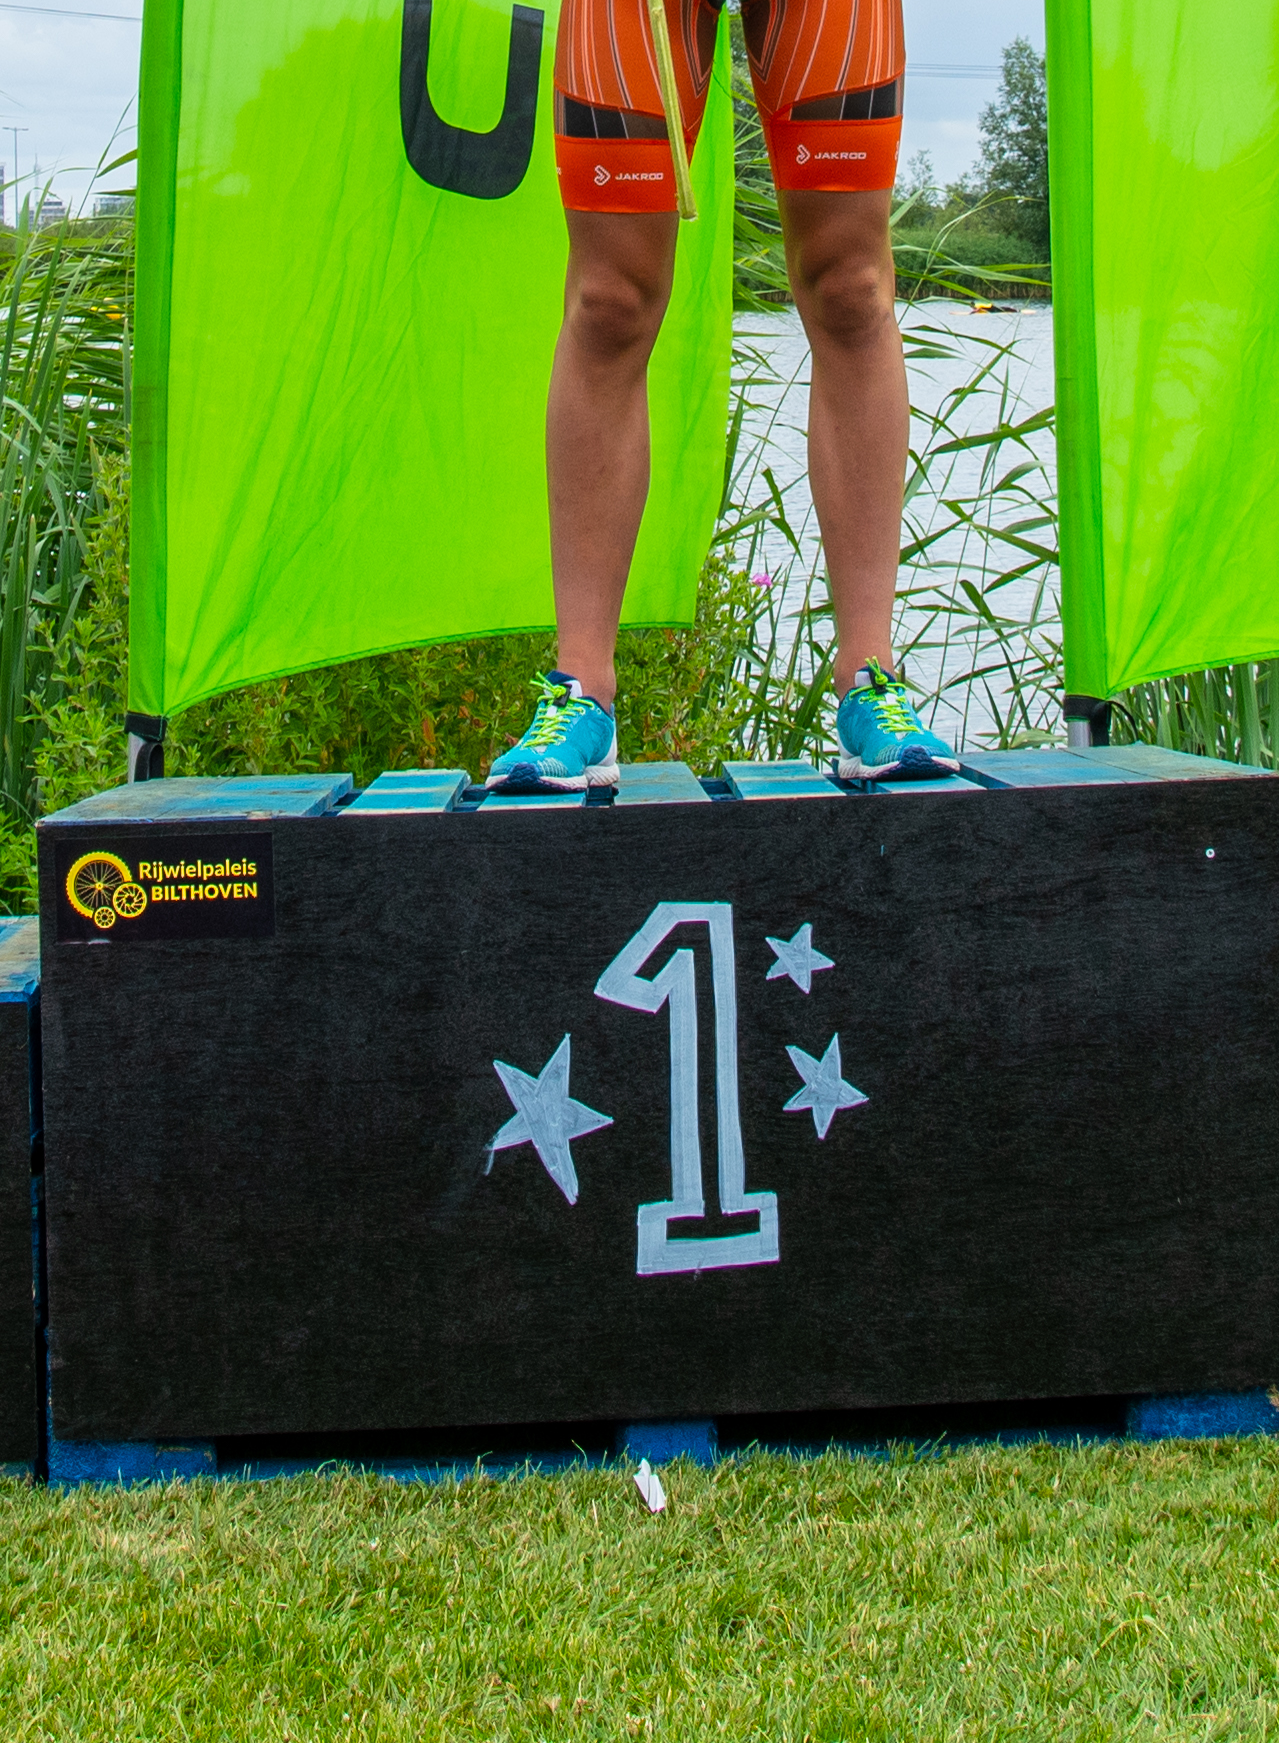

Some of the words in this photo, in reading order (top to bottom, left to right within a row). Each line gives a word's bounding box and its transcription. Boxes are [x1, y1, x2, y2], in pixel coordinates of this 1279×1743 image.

[814, 150, 867, 161] JAKROO
[615, 171, 664, 183] JAKROO
[138, 858, 257, 883] Rijwielpaleis
[150, 882, 259, 903] BILTHOVEN
[593, 901, 781, 1275] 1
